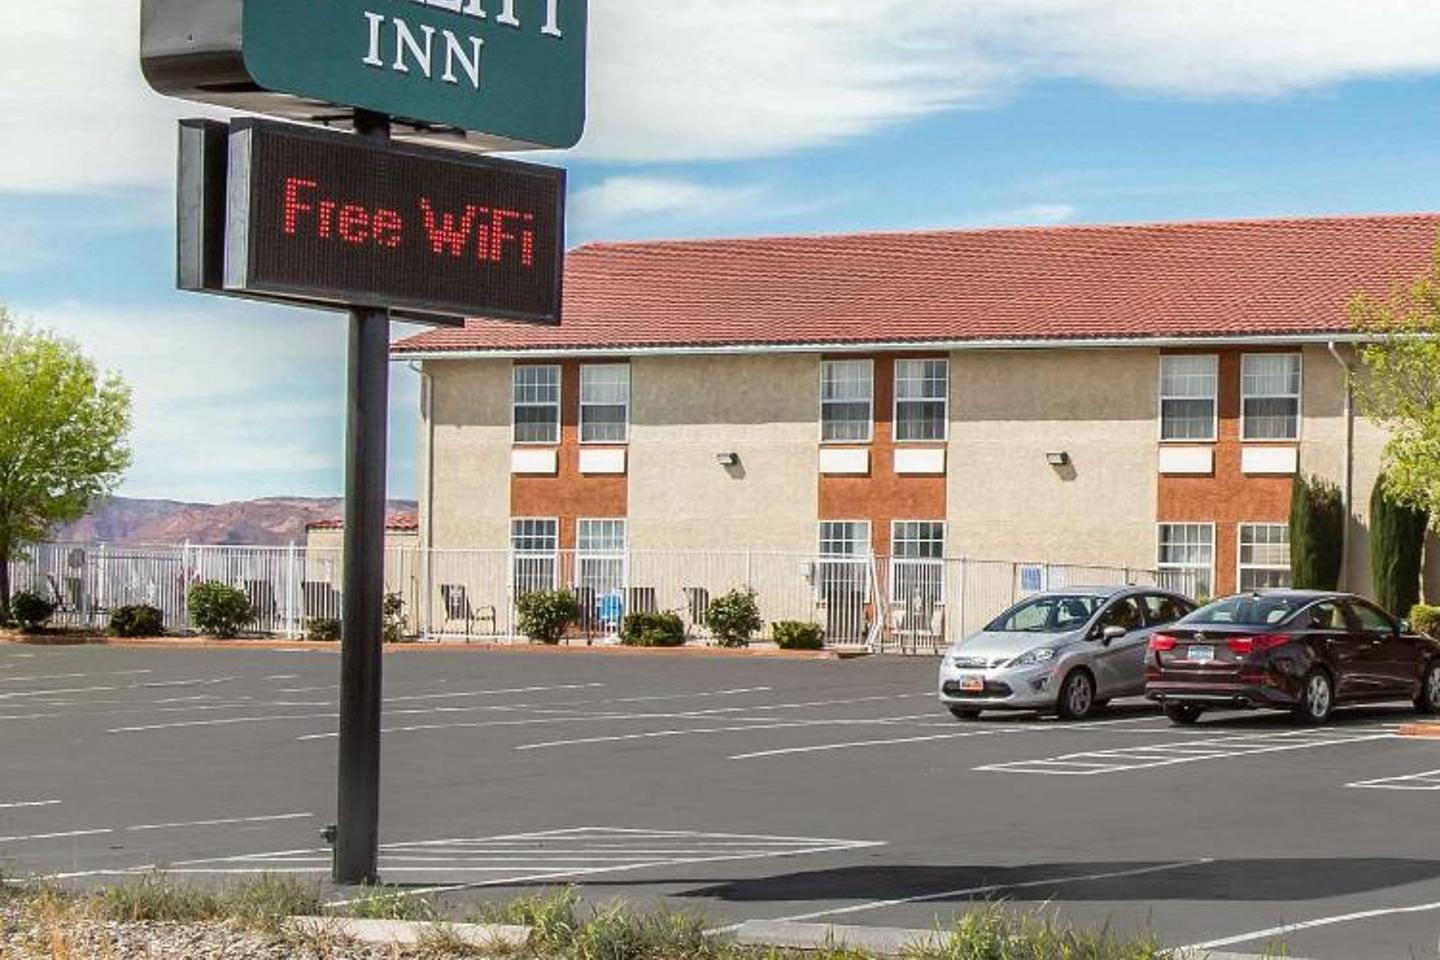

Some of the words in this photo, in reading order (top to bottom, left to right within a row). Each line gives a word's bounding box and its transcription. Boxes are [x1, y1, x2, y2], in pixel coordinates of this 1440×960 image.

[362, 10, 485, 90] INN
[284, 176, 402, 248] Free
[419, 196, 535, 267] WiFi
